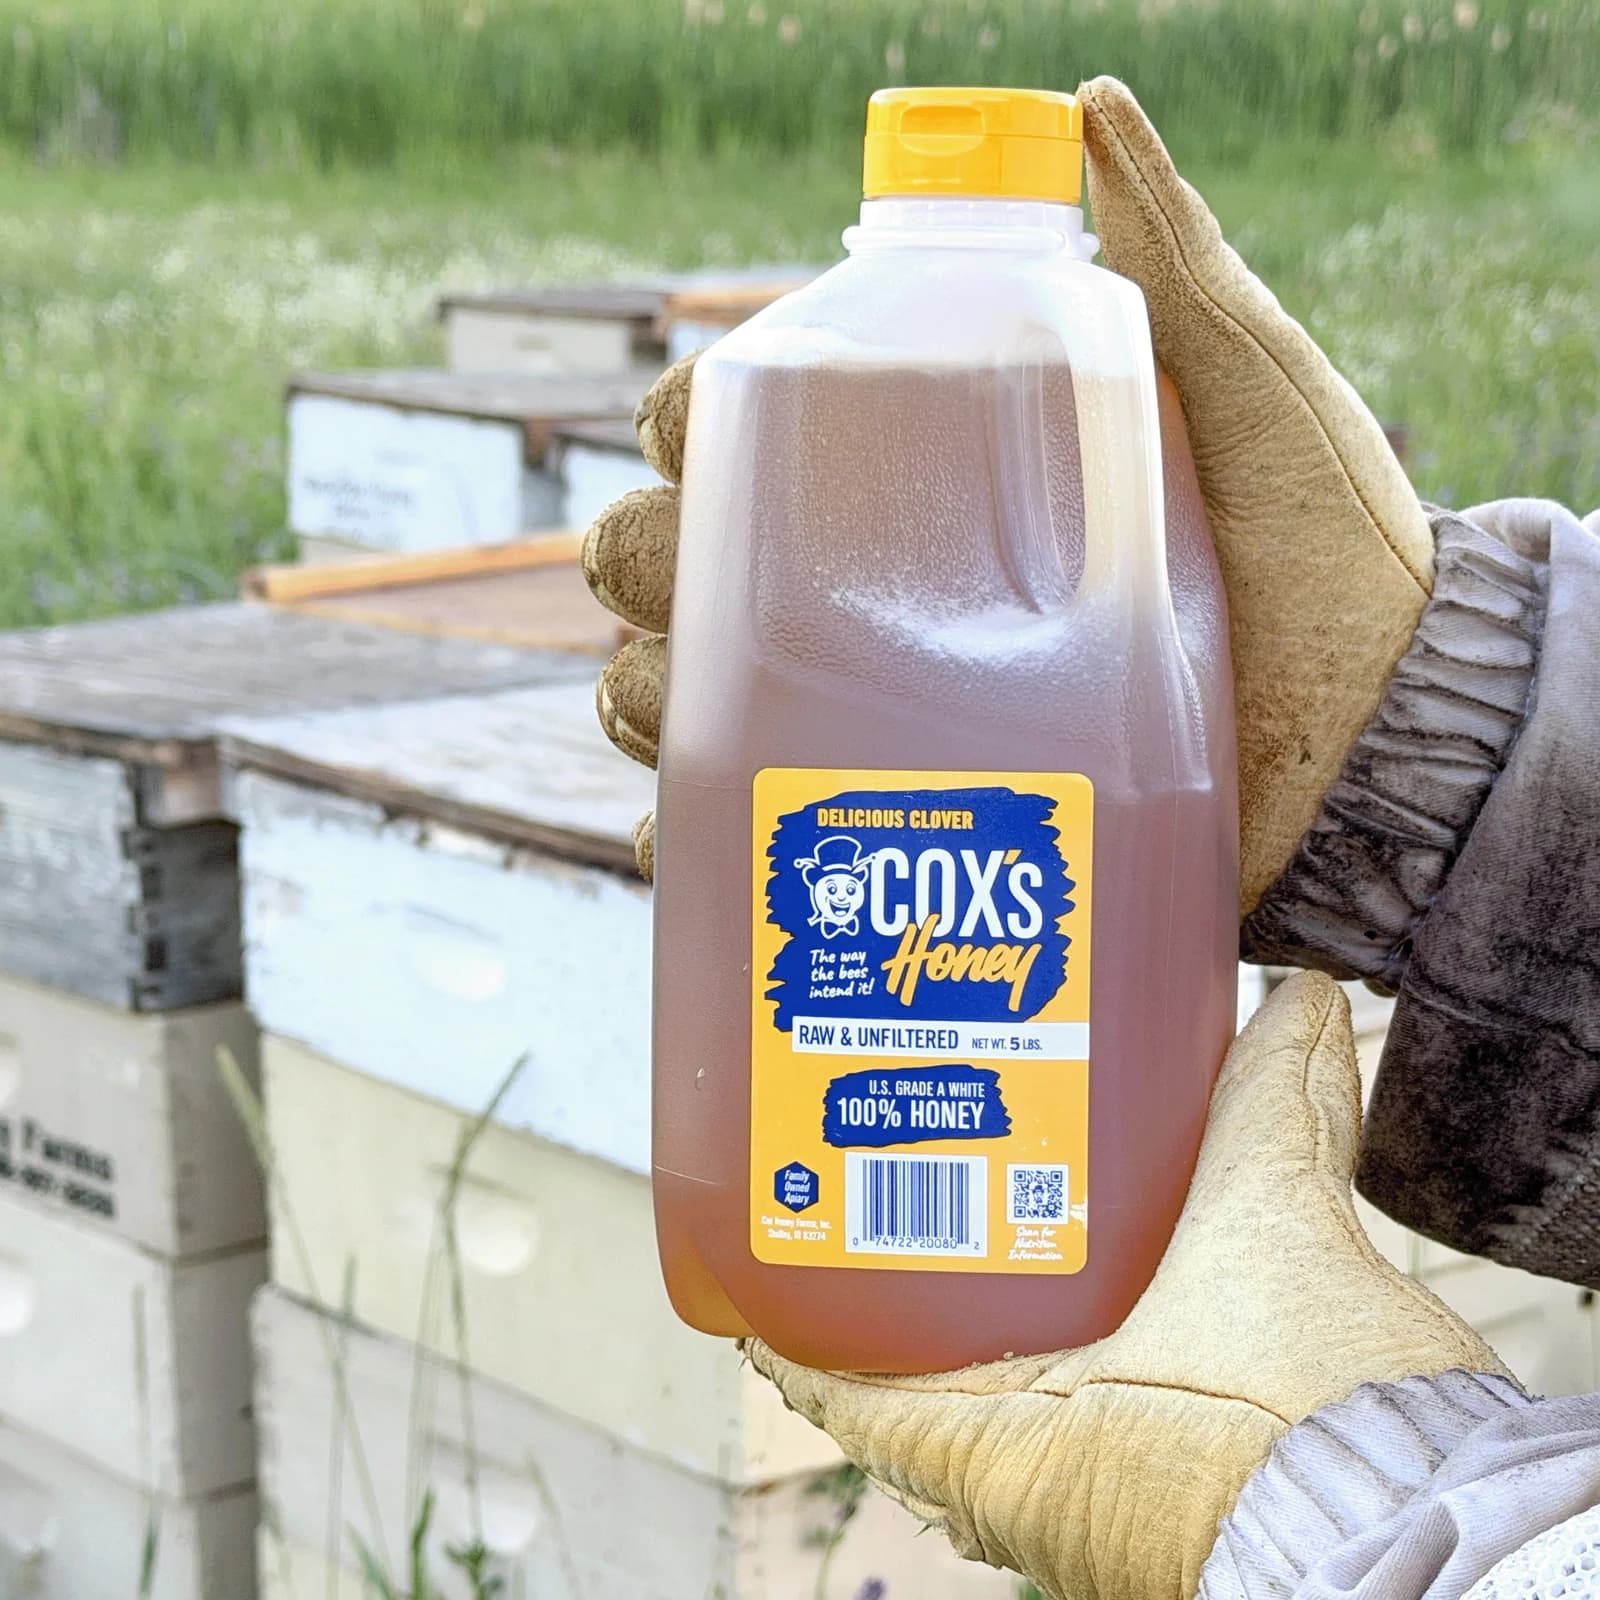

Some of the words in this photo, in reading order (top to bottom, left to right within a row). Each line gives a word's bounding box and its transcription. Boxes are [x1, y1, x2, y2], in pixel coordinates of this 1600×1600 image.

[817, 808, 904, 828] DELICIOUS
[909, 809, 973, 830] CLOVER
[810, 949, 836, 966] The
[840, 951, 866, 966] way
[881, 914, 1041, 1012] Honey
[811, 966, 835, 982] the
[839, 964, 869, 980] bees
[809, 980, 855, 999] intend
[857, 977, 875, 995] it!
[799, 1025, 835, 1046] RAW
[840, 1027, 852, 1047] &
[858, 1028, 959, 1049] UNFILTERED
[971, 1038, 989, 1050] NET
[991, 1038, 1007, 1050] WT.
[1009, 1037, 1020, 1051] 5
[1022, 1038, 1043, 1050] LBS.
[869, 1079, 892, 1096] U.S.
[895, 1081, 934, 1097] GRADE
[936, 1082, 946, 1097] A
[948, 1082, 985, 1098] WHITE
[837, 1097, 902, 1129] 100%
[910, 1099, 985, 1130] HONEY
[784, 1169, 810, 1184] Family
[784, 1181, 811, 1193] Owned
[784, 1192, 810, 1206] Apiary
[852, 1237, 859, 1246] 0
[876, 1236, 913, 1248] 74722
[919, 1238, 958, 1249] 20080
[973, 1241, 981, 1250] 2
